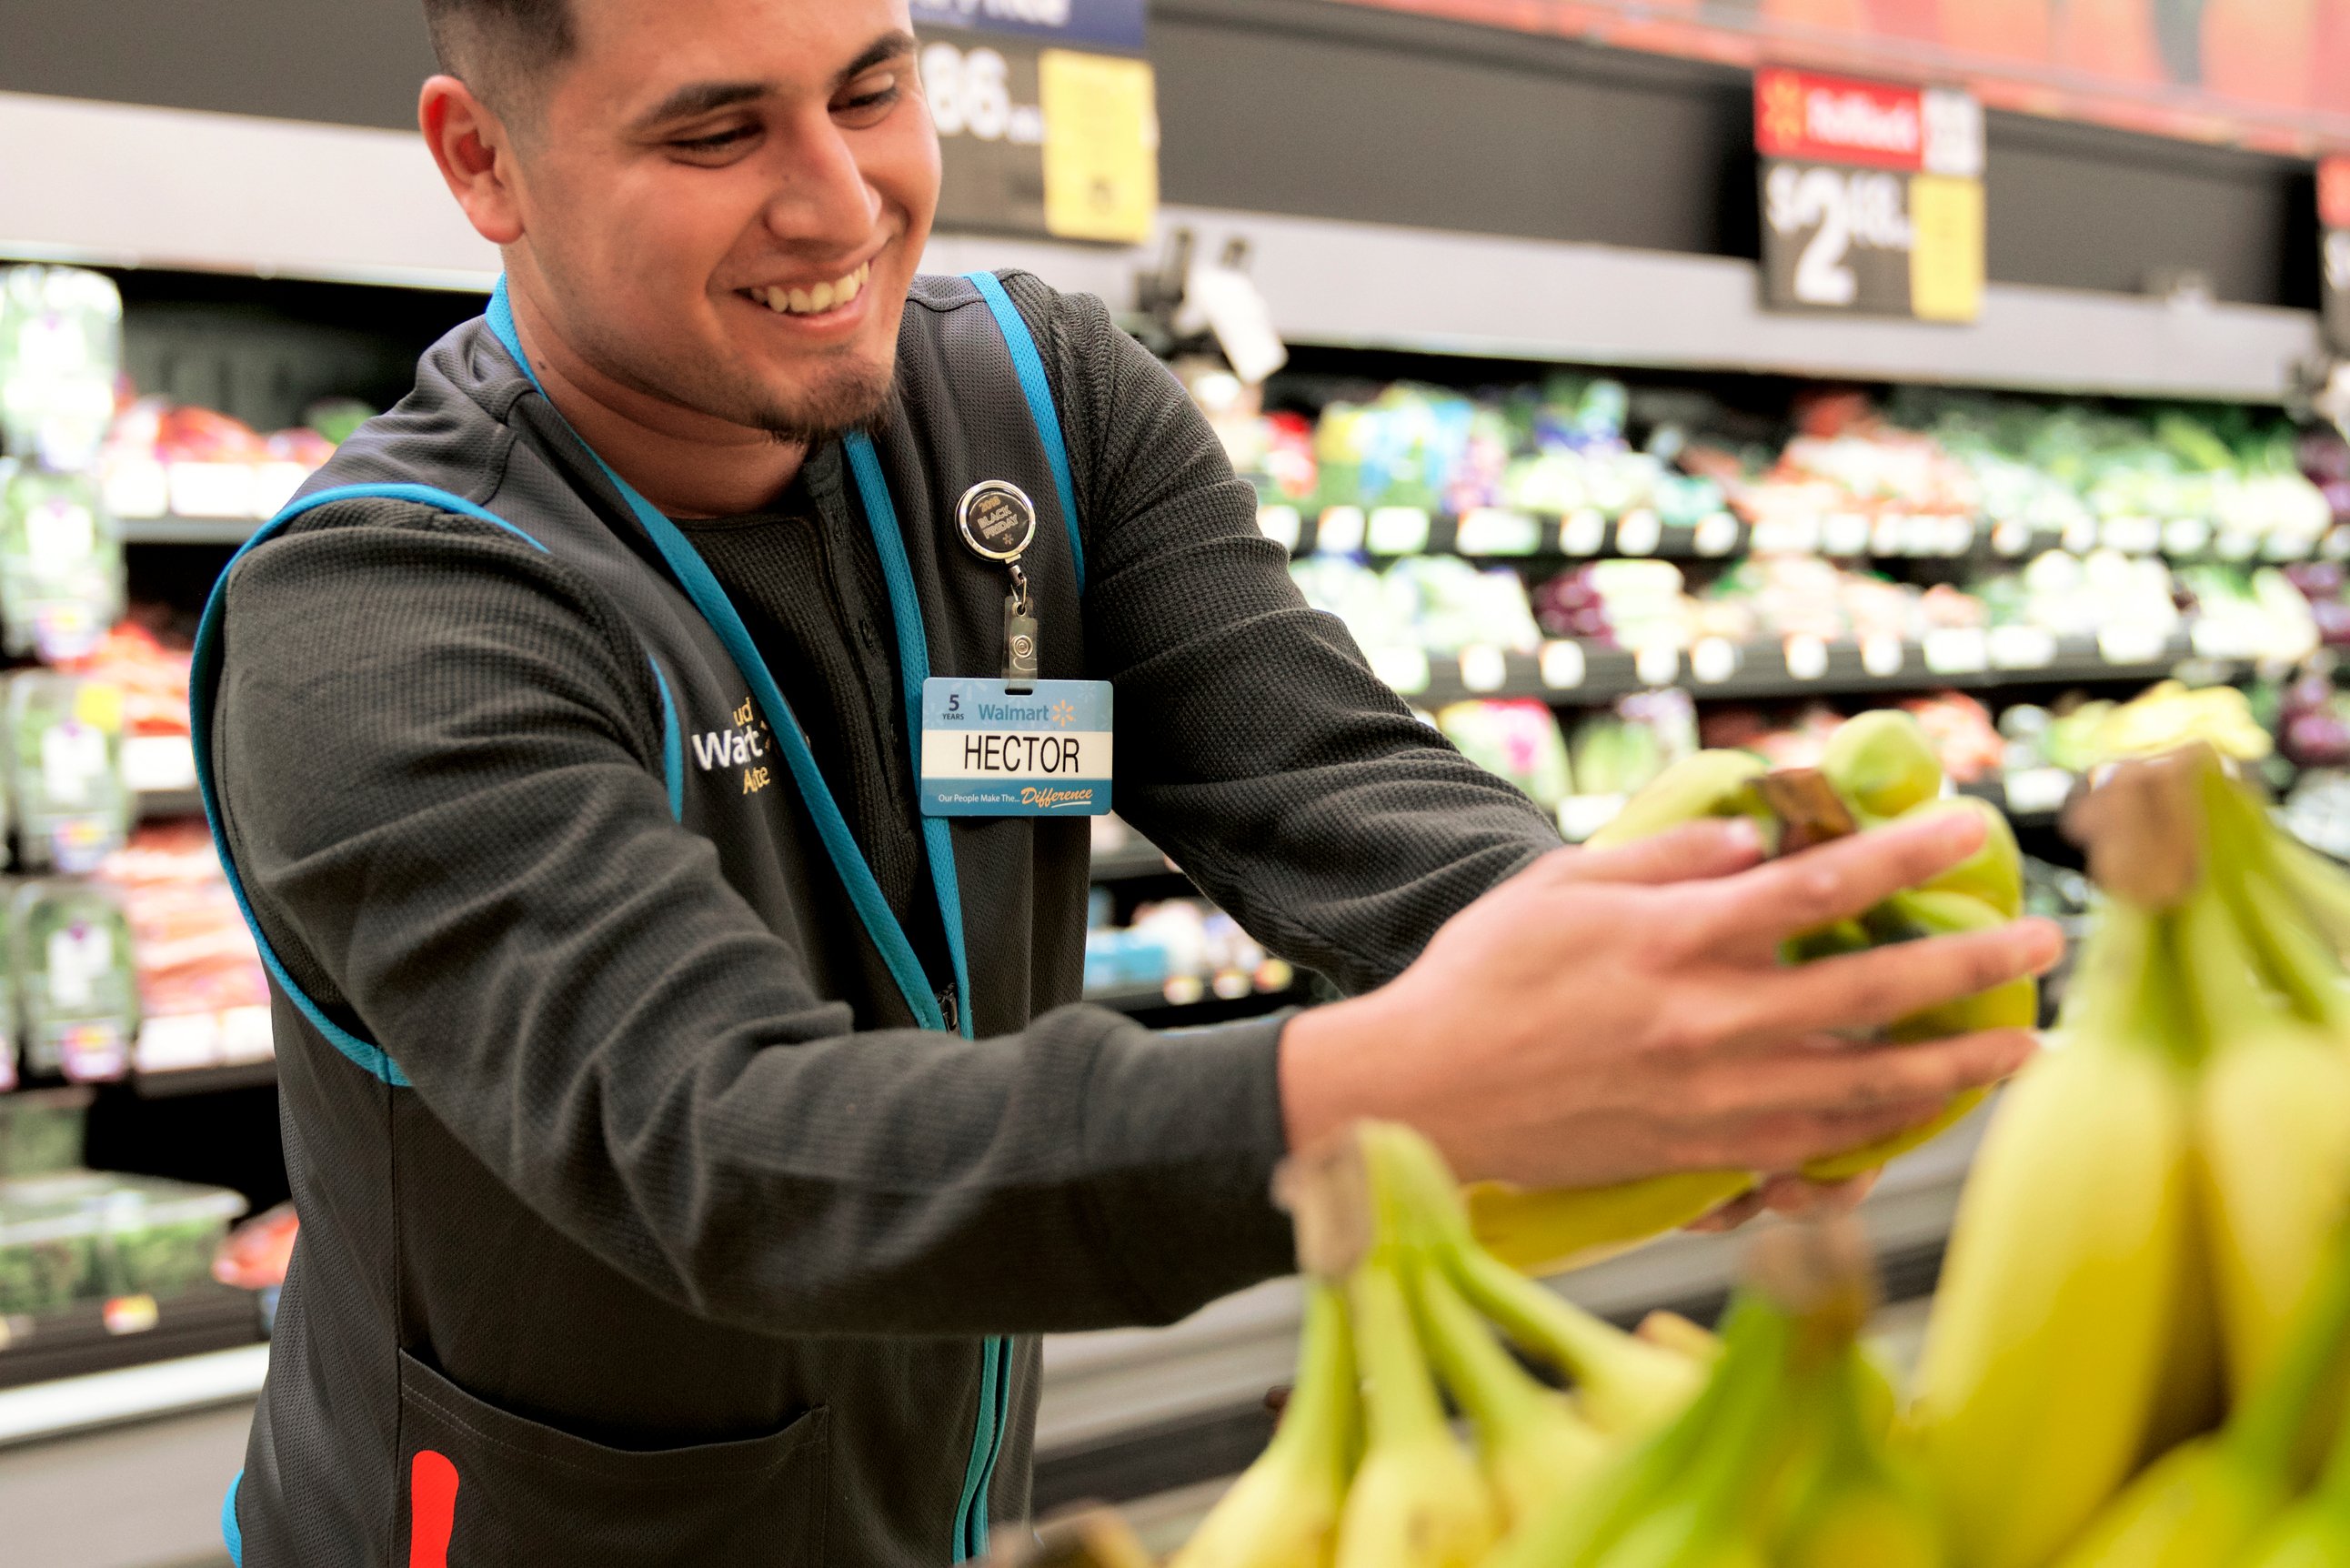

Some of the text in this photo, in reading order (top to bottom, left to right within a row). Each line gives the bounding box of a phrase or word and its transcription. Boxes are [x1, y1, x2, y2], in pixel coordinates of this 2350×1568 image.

[978, 505, 1012, 529] BLACK
[982, 514, 1019, 539] FRIDAY
[949, 694, 959, 711] 5
[978, 703, 1049, 721] Walmart
[964, 734, 1080, 773] HECTOR
[939, 794, 952, 802] Our
[954, 794, 979, 804] People
[980, 794, 1000, 802] Make
[1020, 787, 1092, 808] Difference
